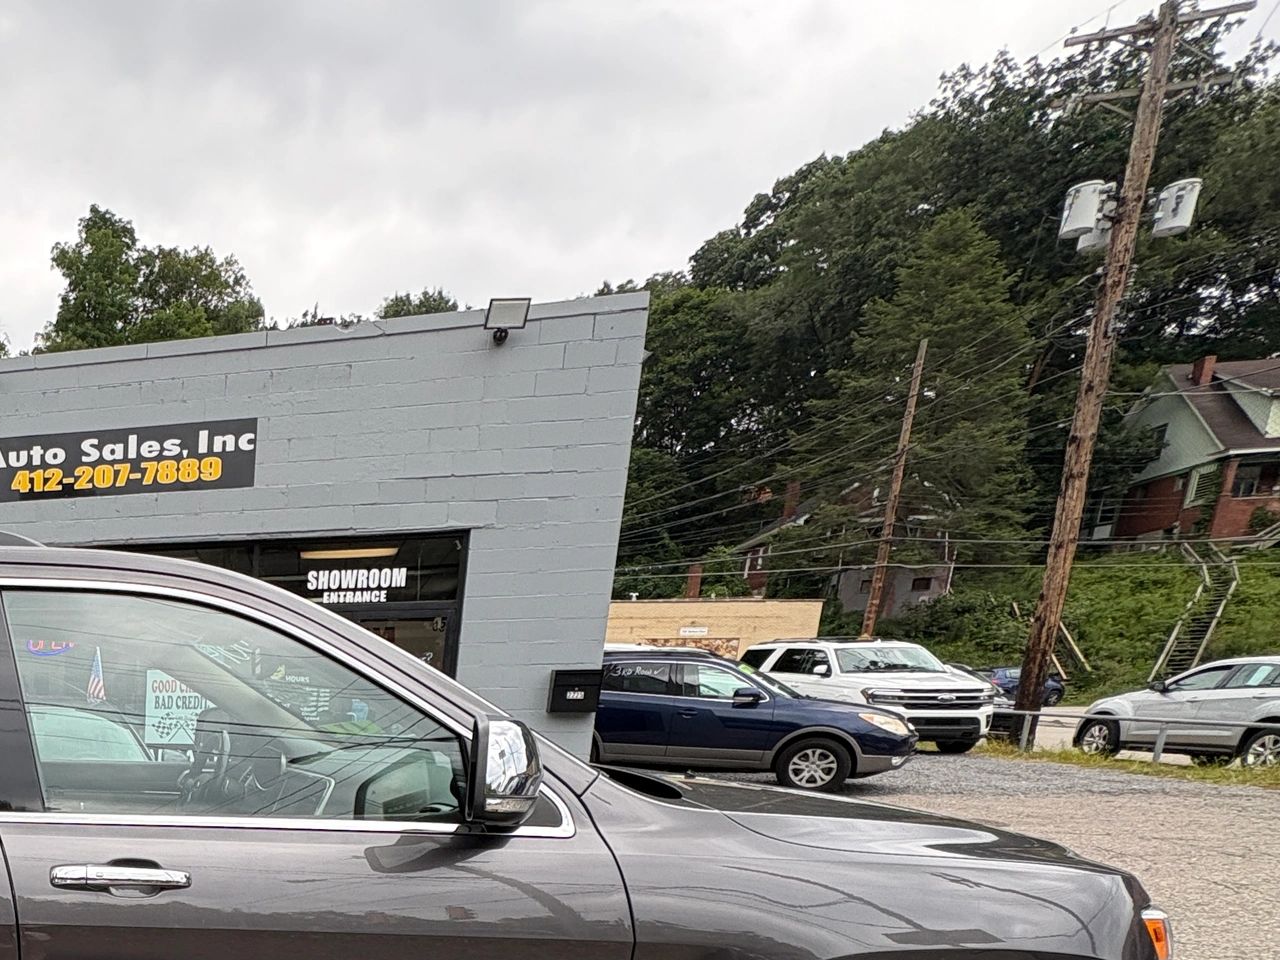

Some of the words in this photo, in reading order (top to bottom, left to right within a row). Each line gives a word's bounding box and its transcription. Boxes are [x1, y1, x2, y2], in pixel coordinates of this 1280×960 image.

[81, 435, 189, 464] Sales,
[198, 429, 255, 454] Inc
[11, 456, 222, 494] 412-207-7889
[306, 567, 407, 591] SHOWROOM
[322, 590, 387, 604] ENTRANCE
[151, 679, 177, 693] GOOD
[285, 675, 310, 683] HOURS
[154, 695, 174, 710] BAD
